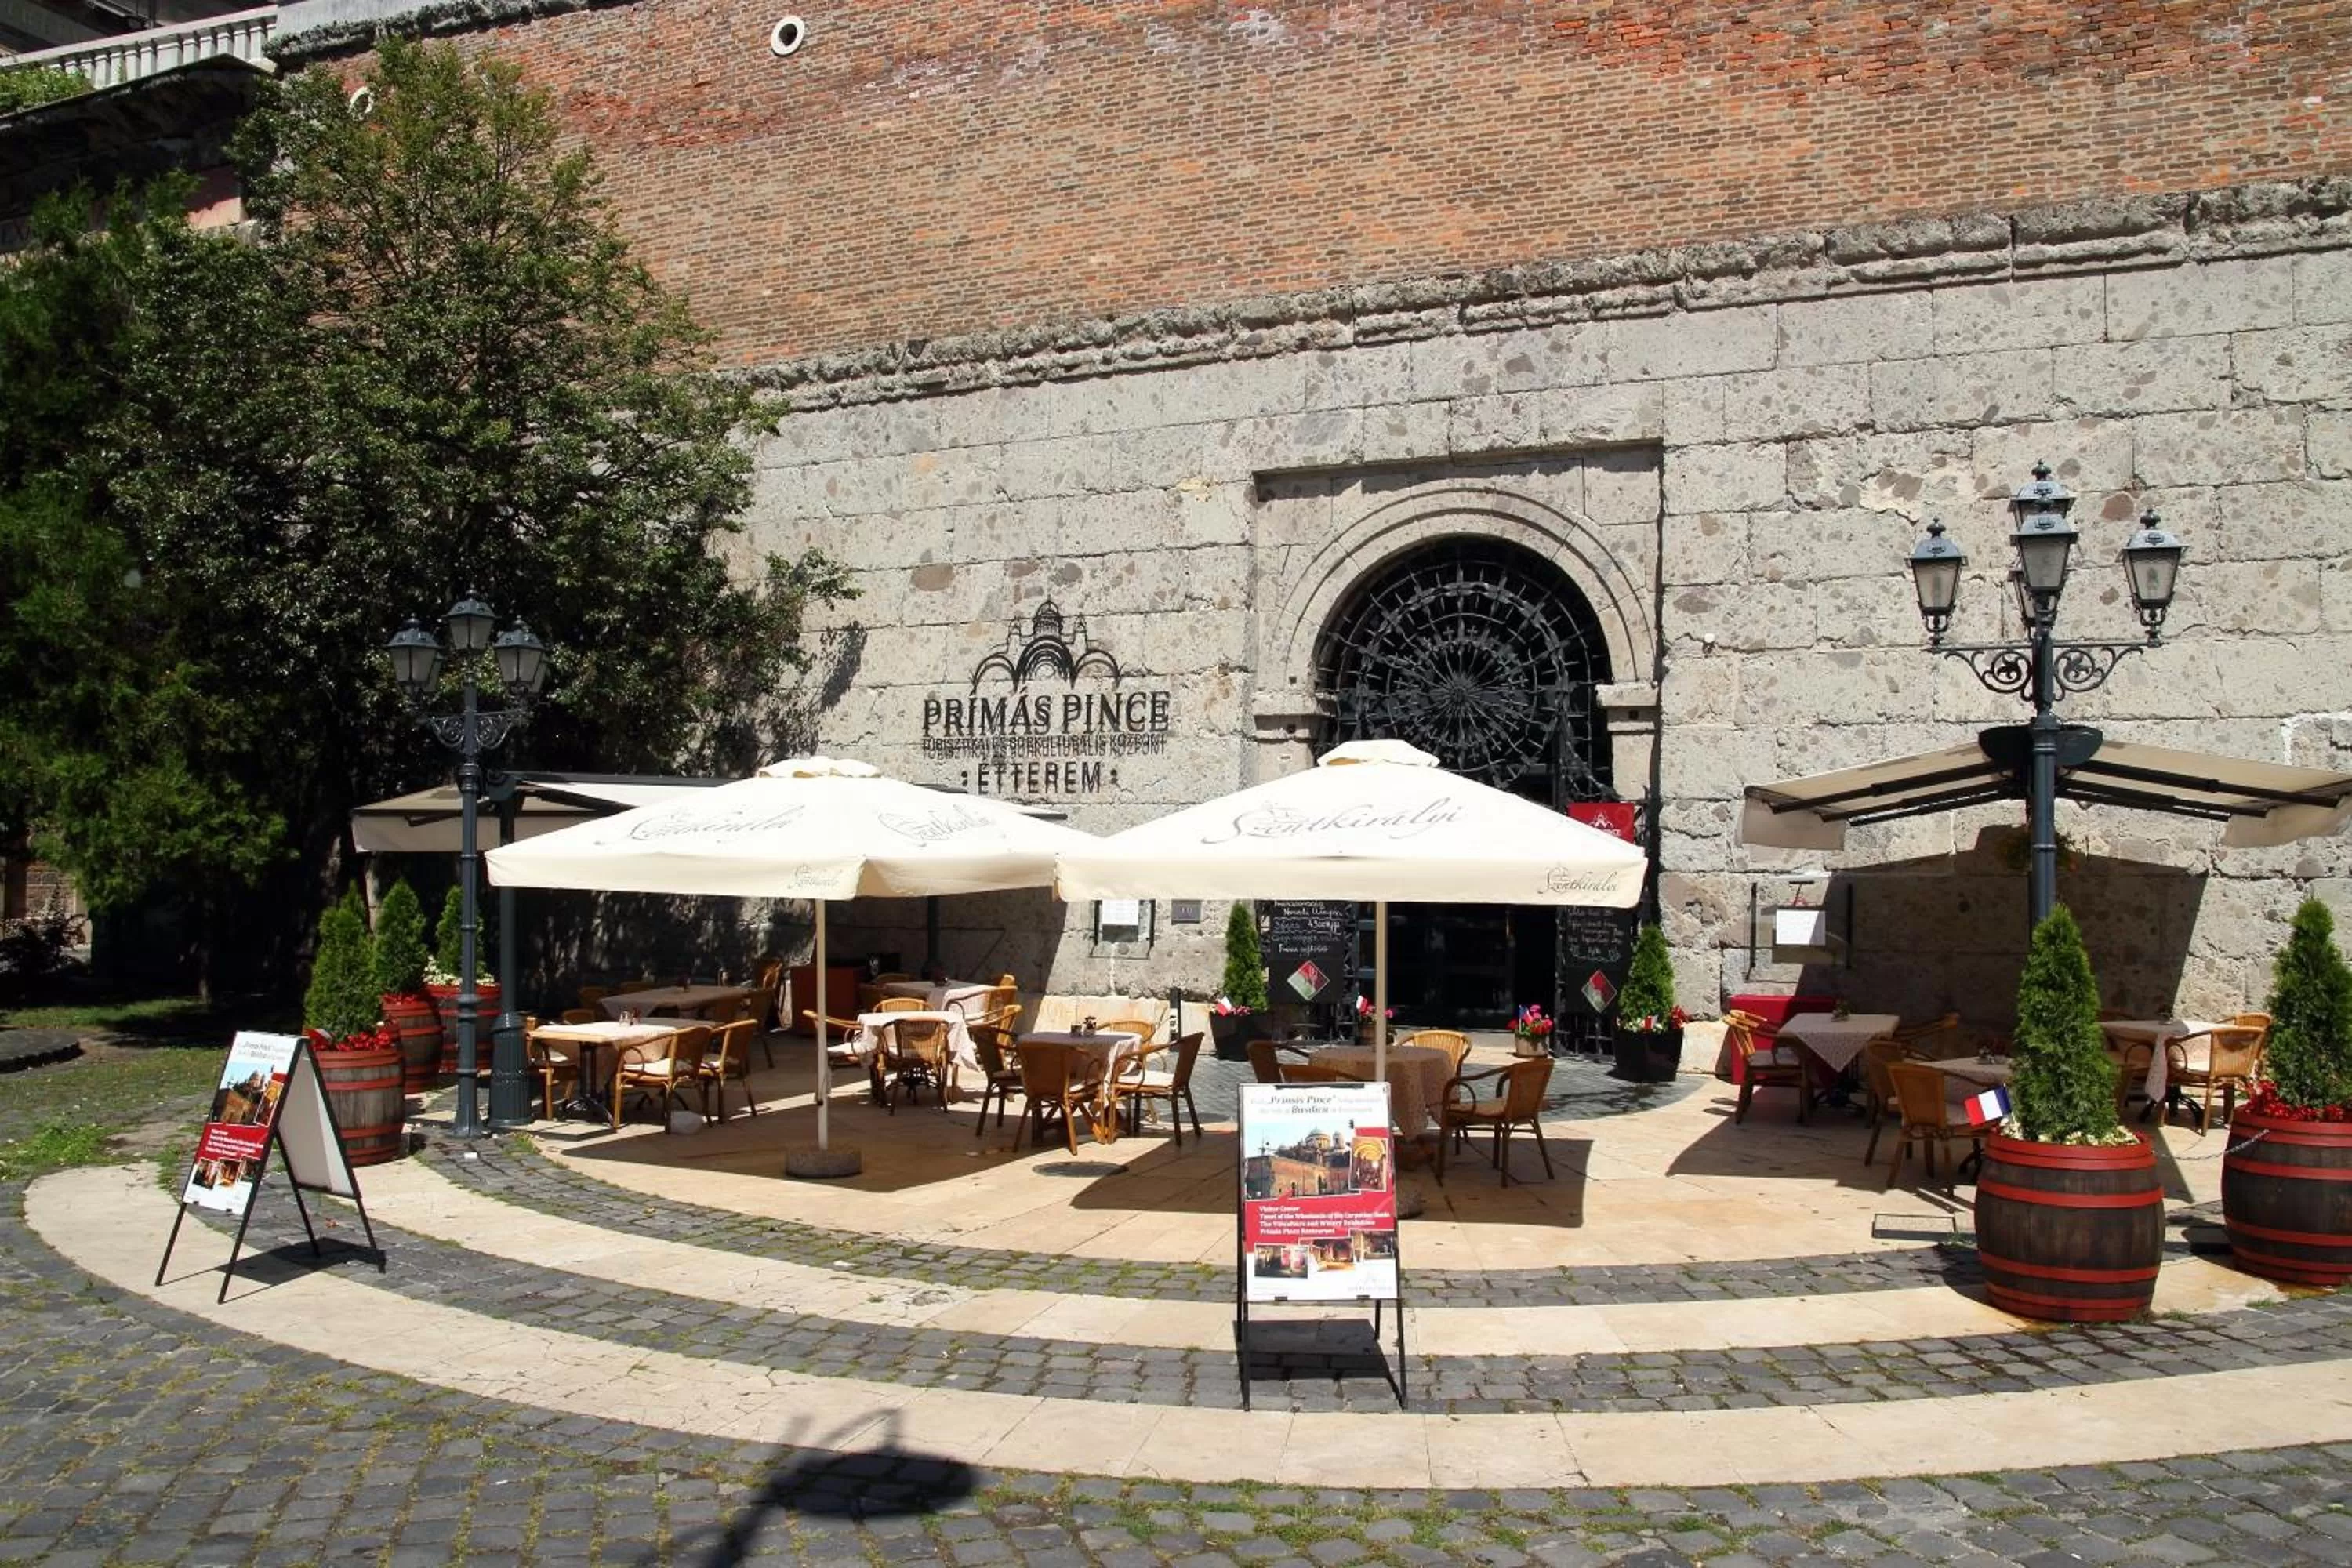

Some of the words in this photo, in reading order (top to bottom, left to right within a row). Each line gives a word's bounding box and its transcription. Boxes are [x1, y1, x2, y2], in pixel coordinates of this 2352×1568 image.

[922, 686, 1051, 736] PRÍMÁS
[1062, 691, 1171, 734] PINCE
[978, 761, 1101, 794] ÉTTEREM
